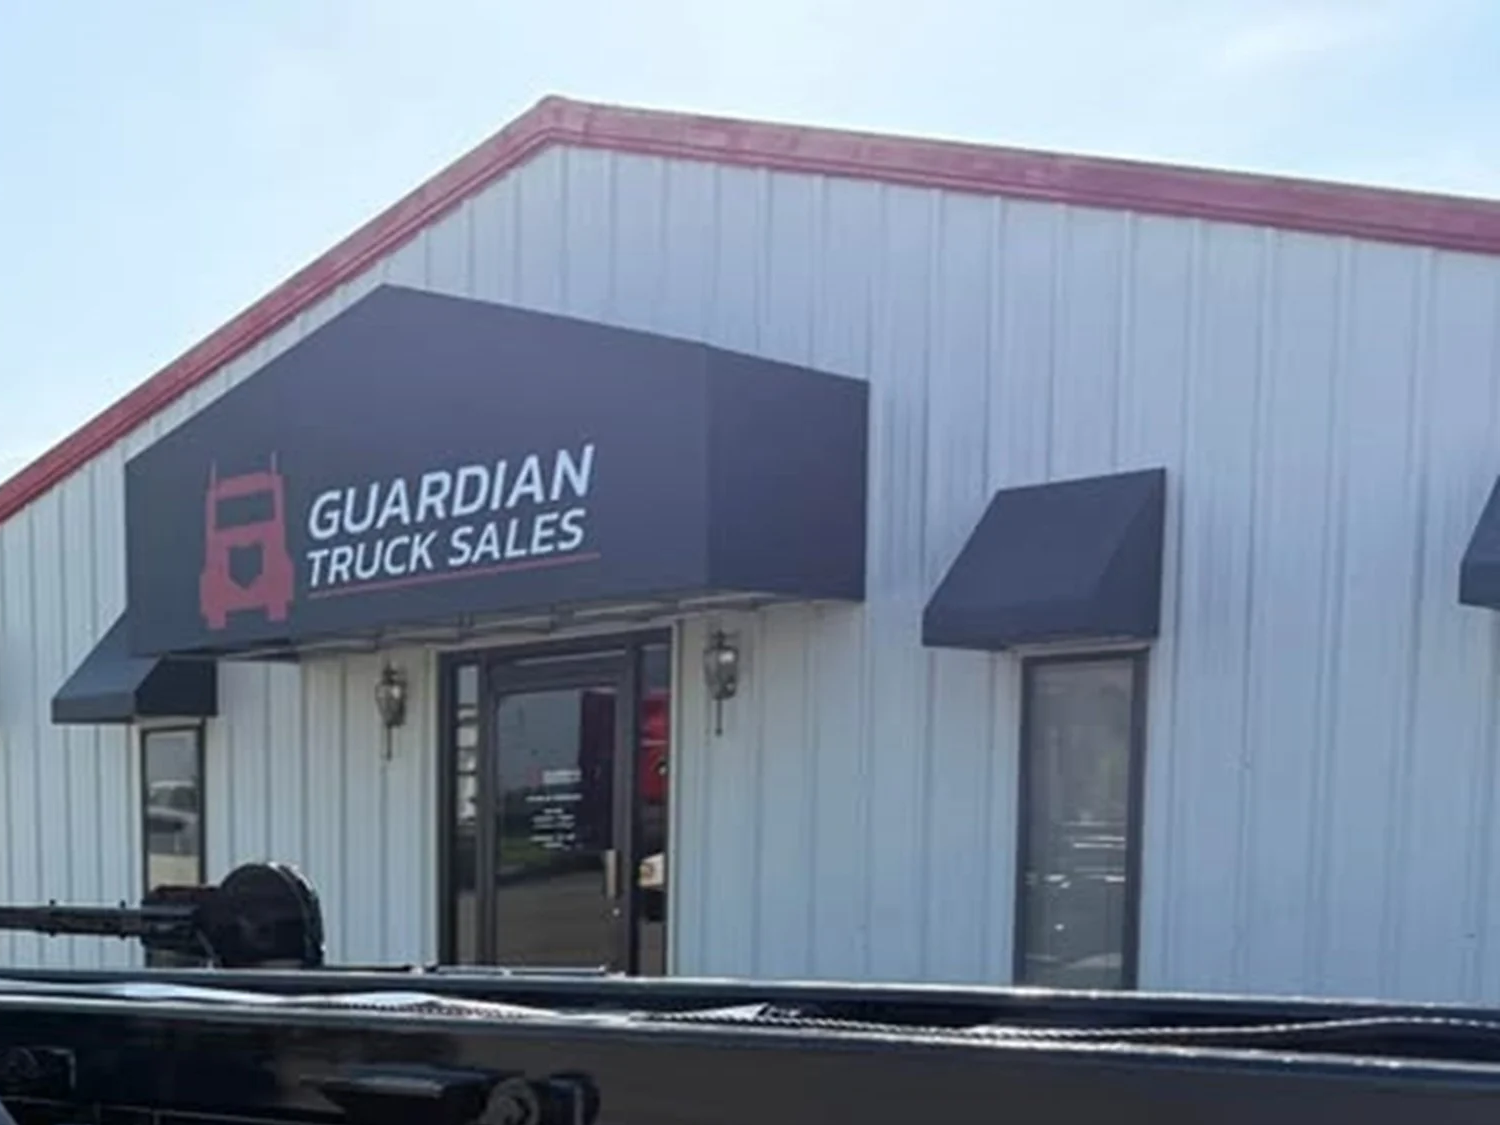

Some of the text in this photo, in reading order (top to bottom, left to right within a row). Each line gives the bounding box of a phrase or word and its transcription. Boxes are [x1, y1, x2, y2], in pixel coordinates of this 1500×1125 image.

[309, 443, 594, 540] GUARDIAN
[307, 508, 586, 587] TRUCK SALES
